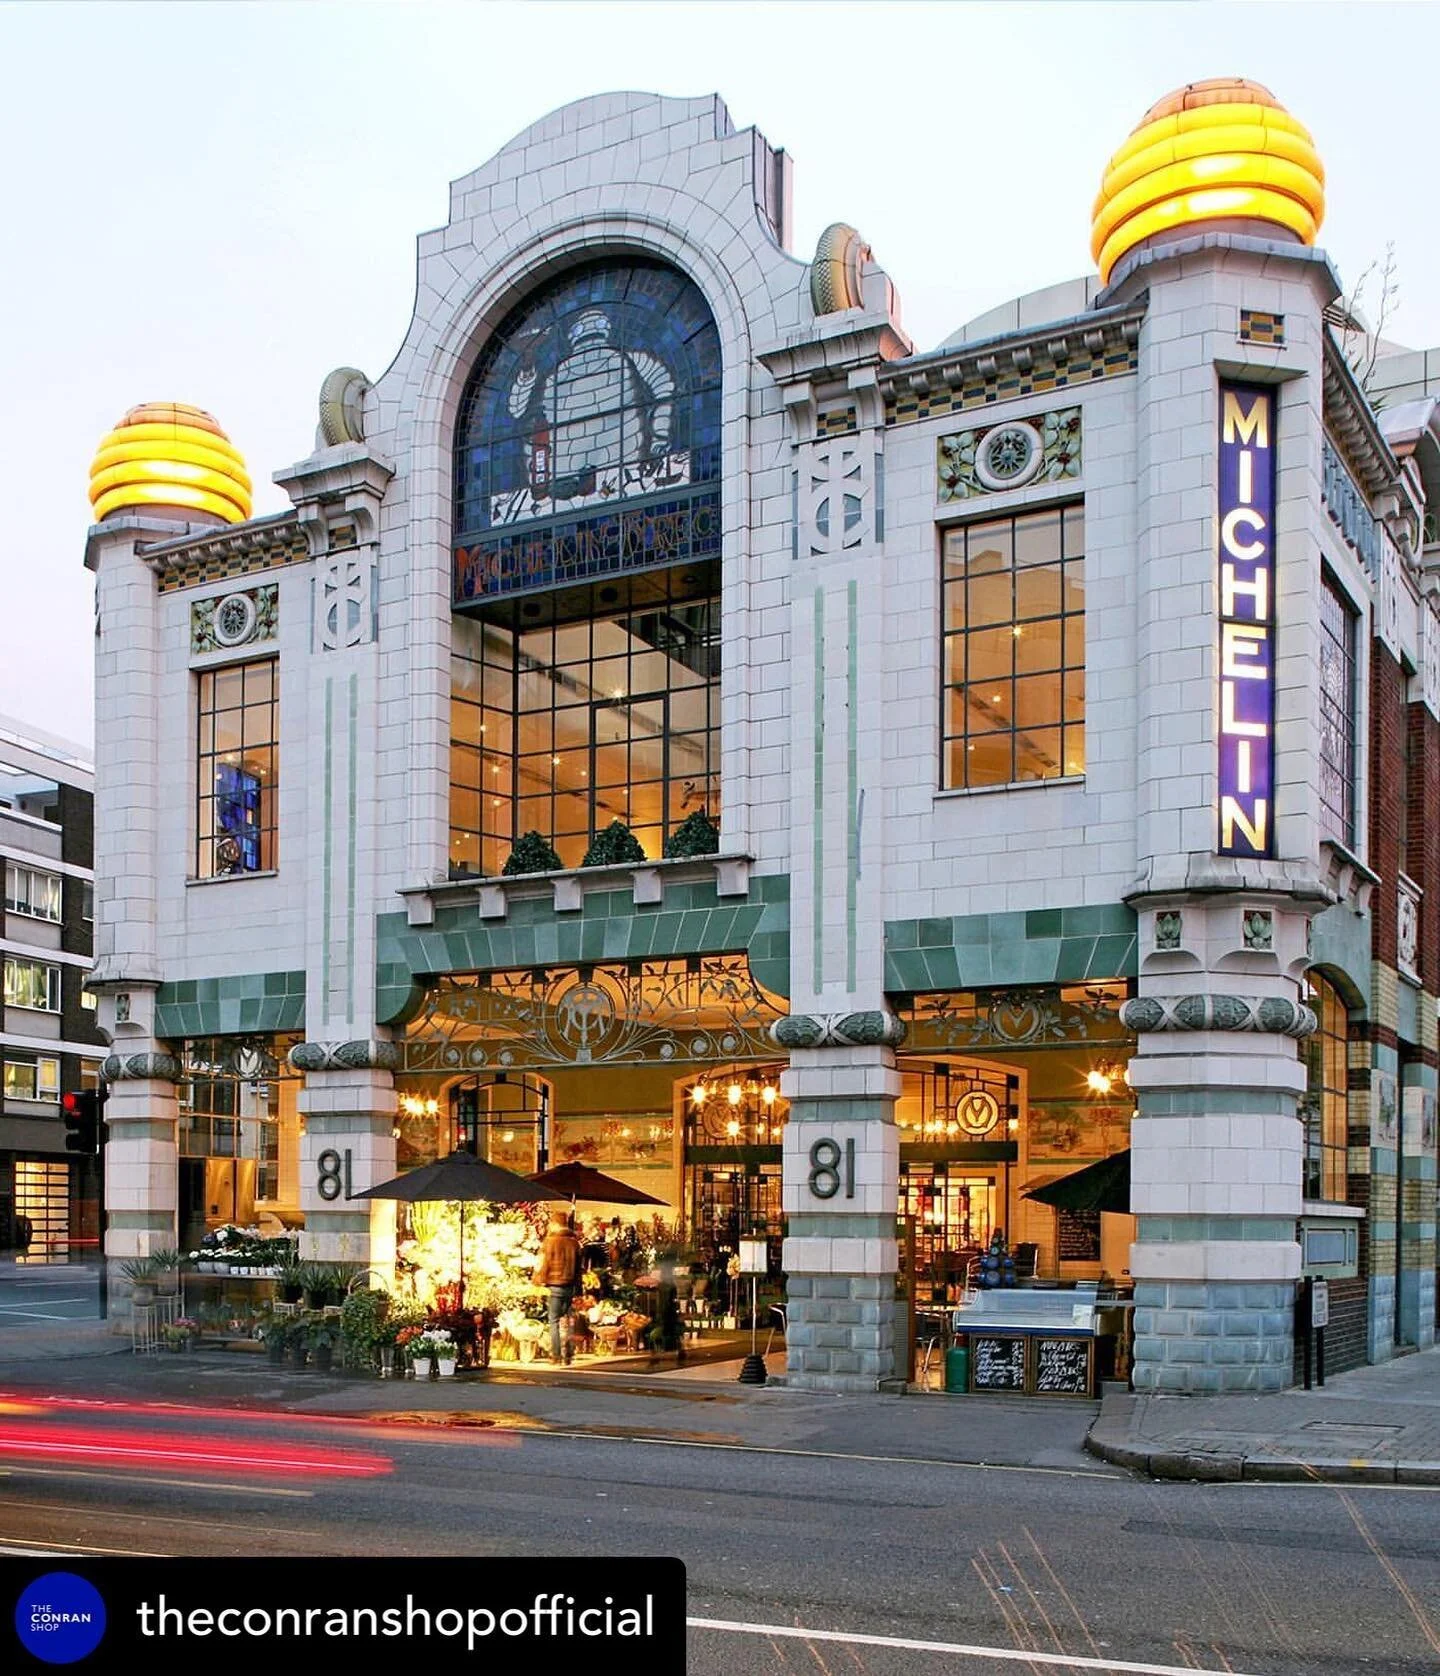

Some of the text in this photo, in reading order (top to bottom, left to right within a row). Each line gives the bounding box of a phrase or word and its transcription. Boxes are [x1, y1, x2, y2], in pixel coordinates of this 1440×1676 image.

[1220, 391, 1269, 853] MICHELIN
[318, 1149, 352, 1201] 81
[809, 1137, 855, 1200] 81
